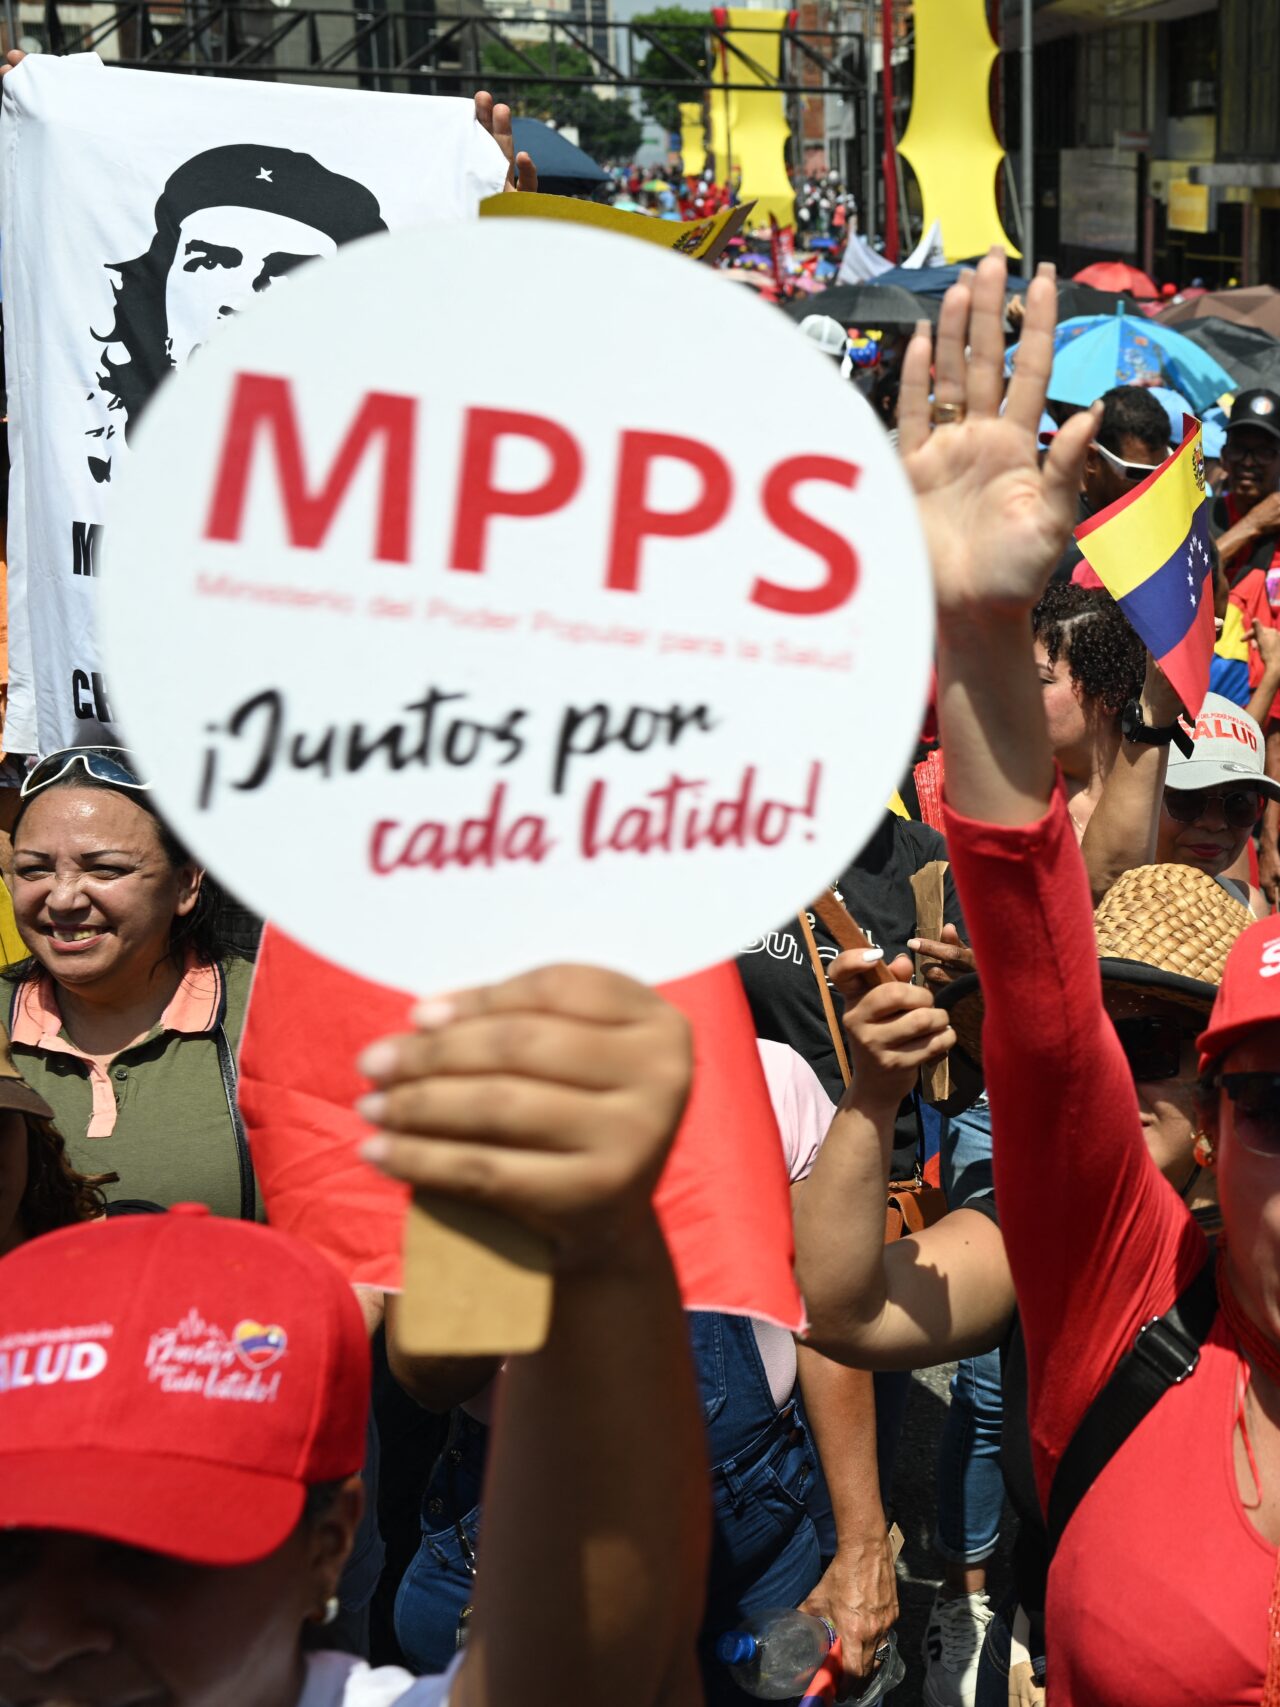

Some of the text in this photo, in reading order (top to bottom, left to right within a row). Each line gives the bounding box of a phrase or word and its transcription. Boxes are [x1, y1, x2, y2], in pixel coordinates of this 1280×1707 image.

[203, 370, 863, 617] MPPS
[198, 686, 719, 810] ¡Juntos por
[368, 759, 822, 875] cada latido!
